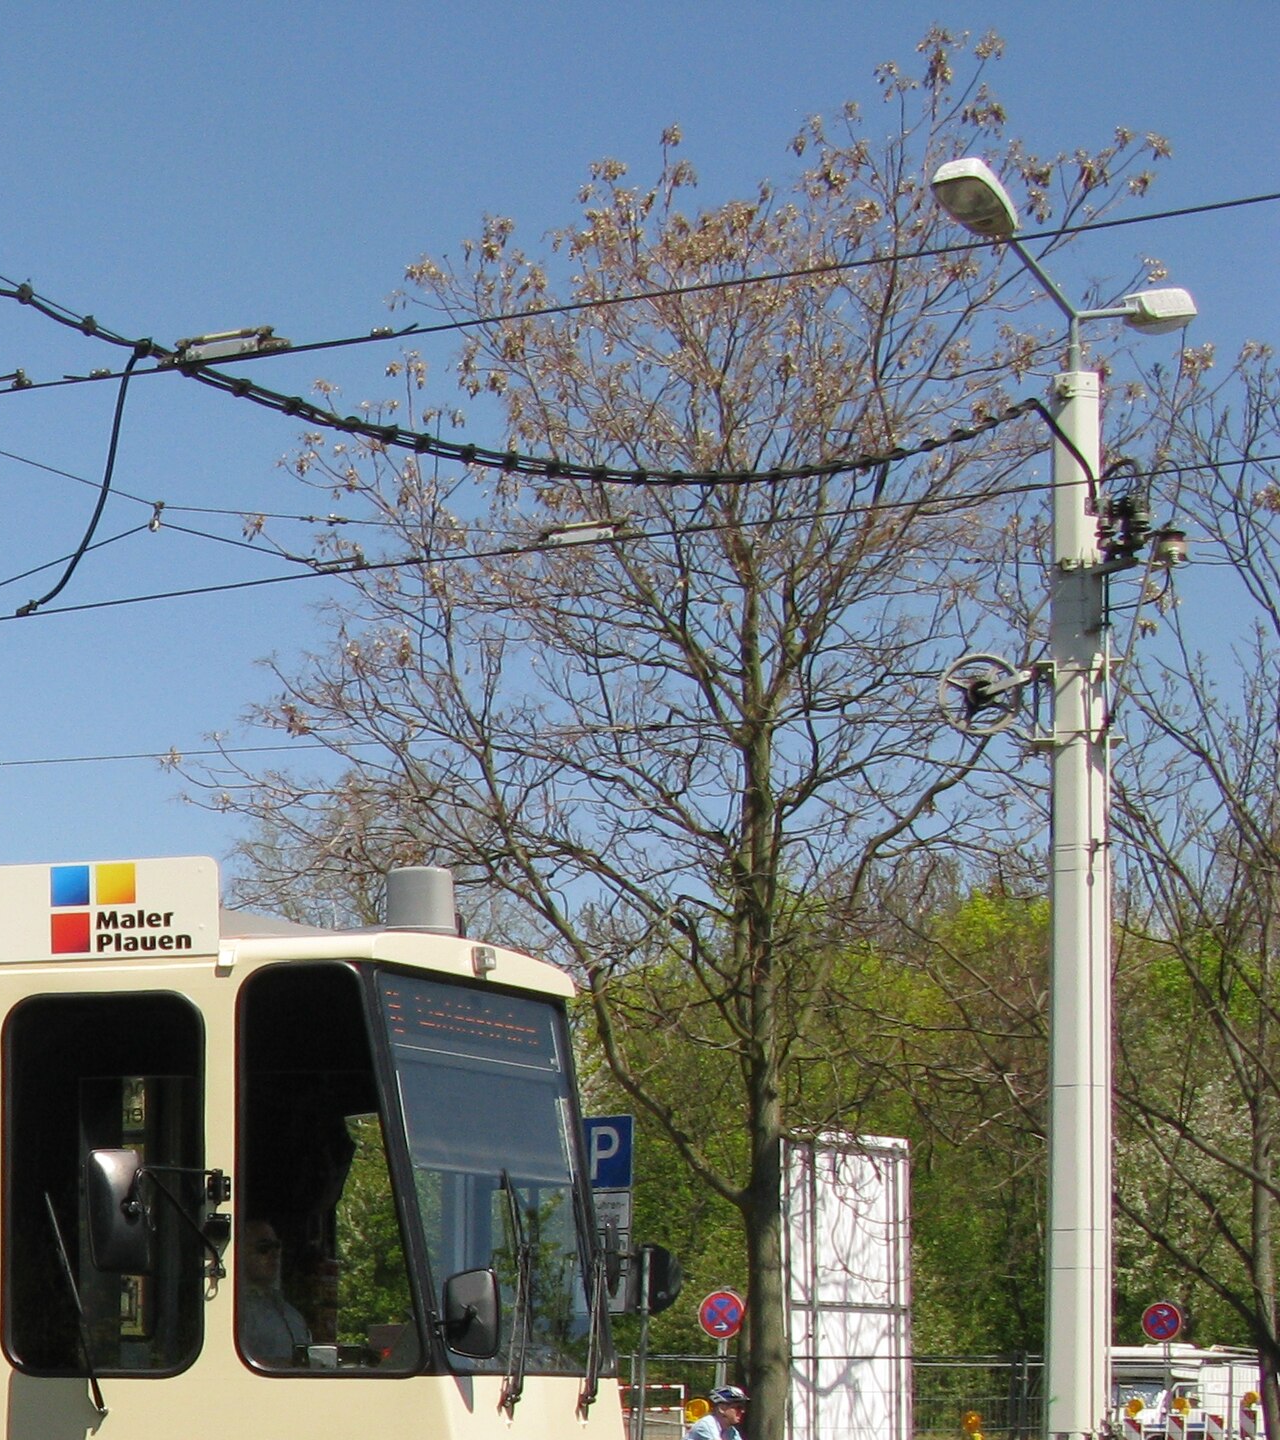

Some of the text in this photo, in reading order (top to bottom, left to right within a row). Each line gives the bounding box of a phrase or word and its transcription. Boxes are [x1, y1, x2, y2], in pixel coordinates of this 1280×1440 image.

[96, 909, 175, 930] Maler
[96, 928, 193, 952] Plauen
[591, 1126, 620, 1180] P
